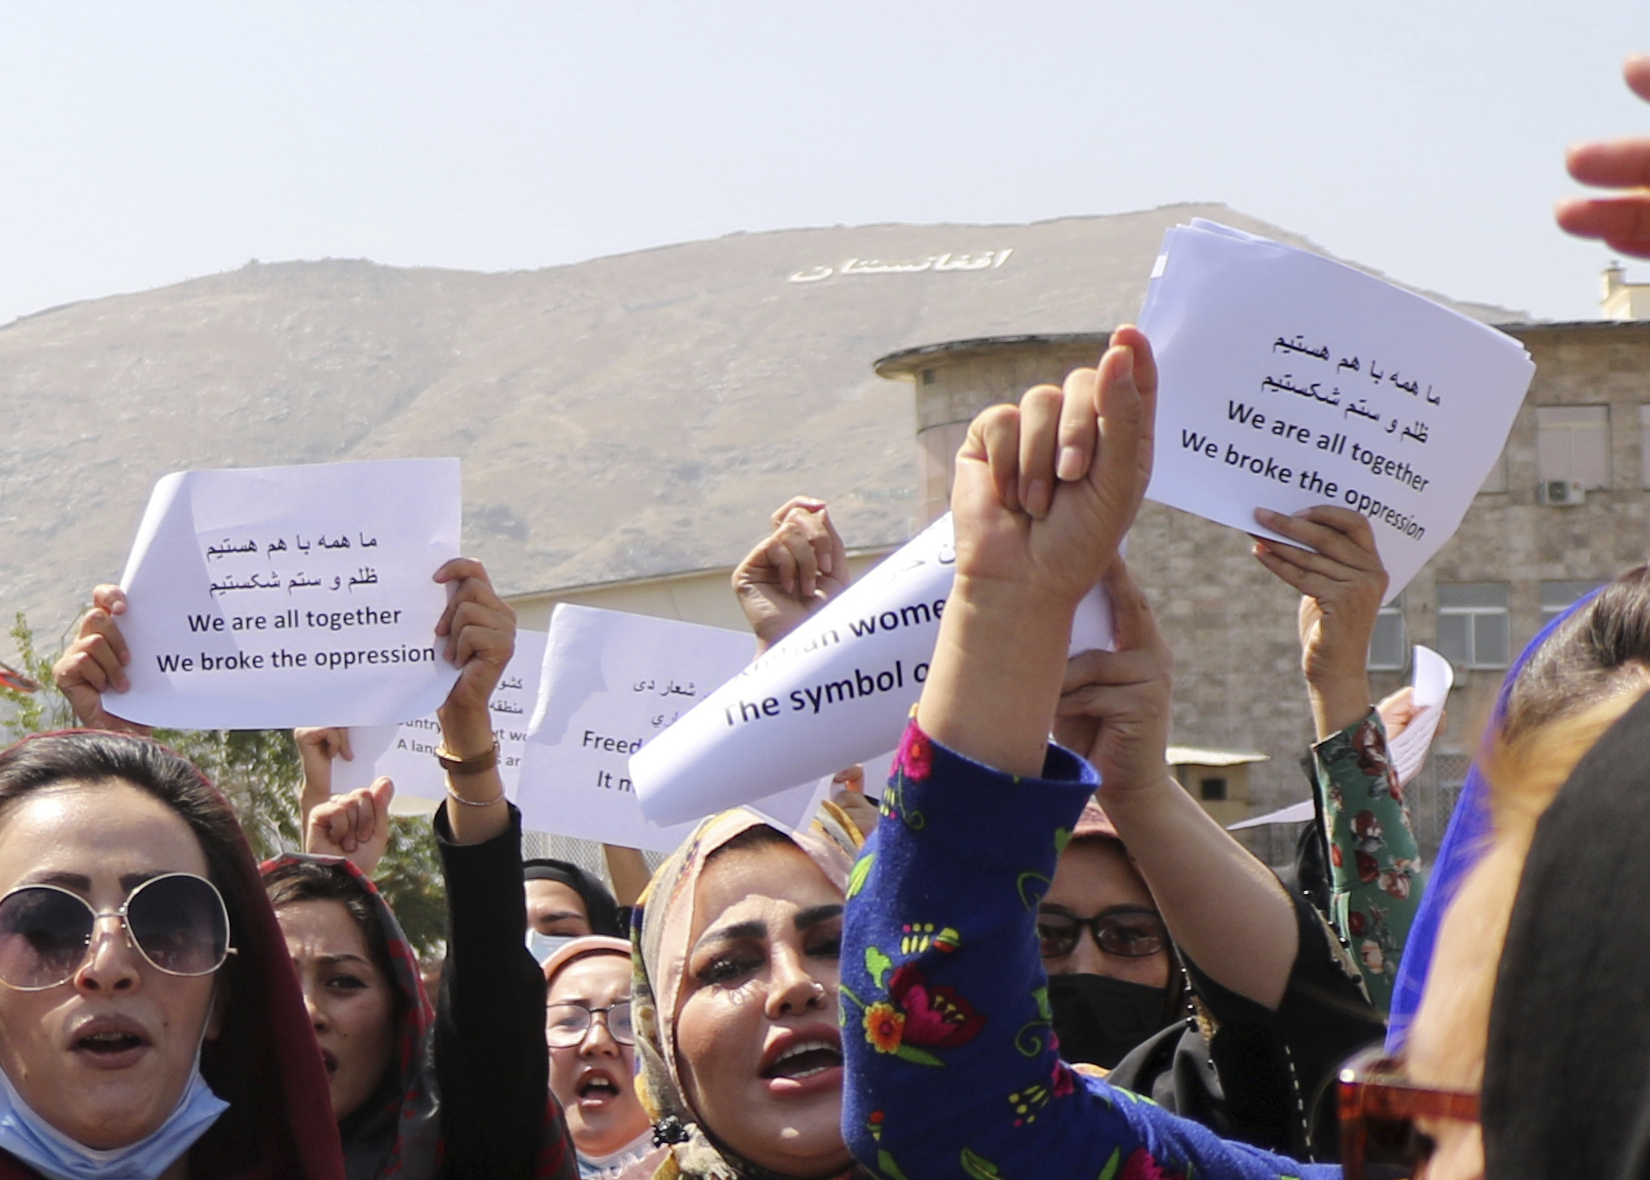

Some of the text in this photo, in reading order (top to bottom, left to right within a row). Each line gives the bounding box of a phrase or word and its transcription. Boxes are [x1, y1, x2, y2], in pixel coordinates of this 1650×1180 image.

[1273, 335, 1441, 406] ما همه با هم هستیم
[1343, 399, 1381, 421] ستم
[1385, 418, 1398, 433] و
[1400, 420, 1429, 443] ظلم
[1228, 400, 1429, 493] We are all together
[1181, 429, 1425, 541] We broke the oppression
[207, 533, 377, 560] ما همه با هم هستیم
[288, 572, 321, 595] ستم
[330, 578, 341, 590] و
[349, 567, 377, 592] ظلم
[188, 606, 402, 632] We are all together
[156, 645, 436, 672] We broke the oppression
[790, 660, 902, 714] symbol
[398, 739, 408, 750] A
[598, 770, 613, 789] It
